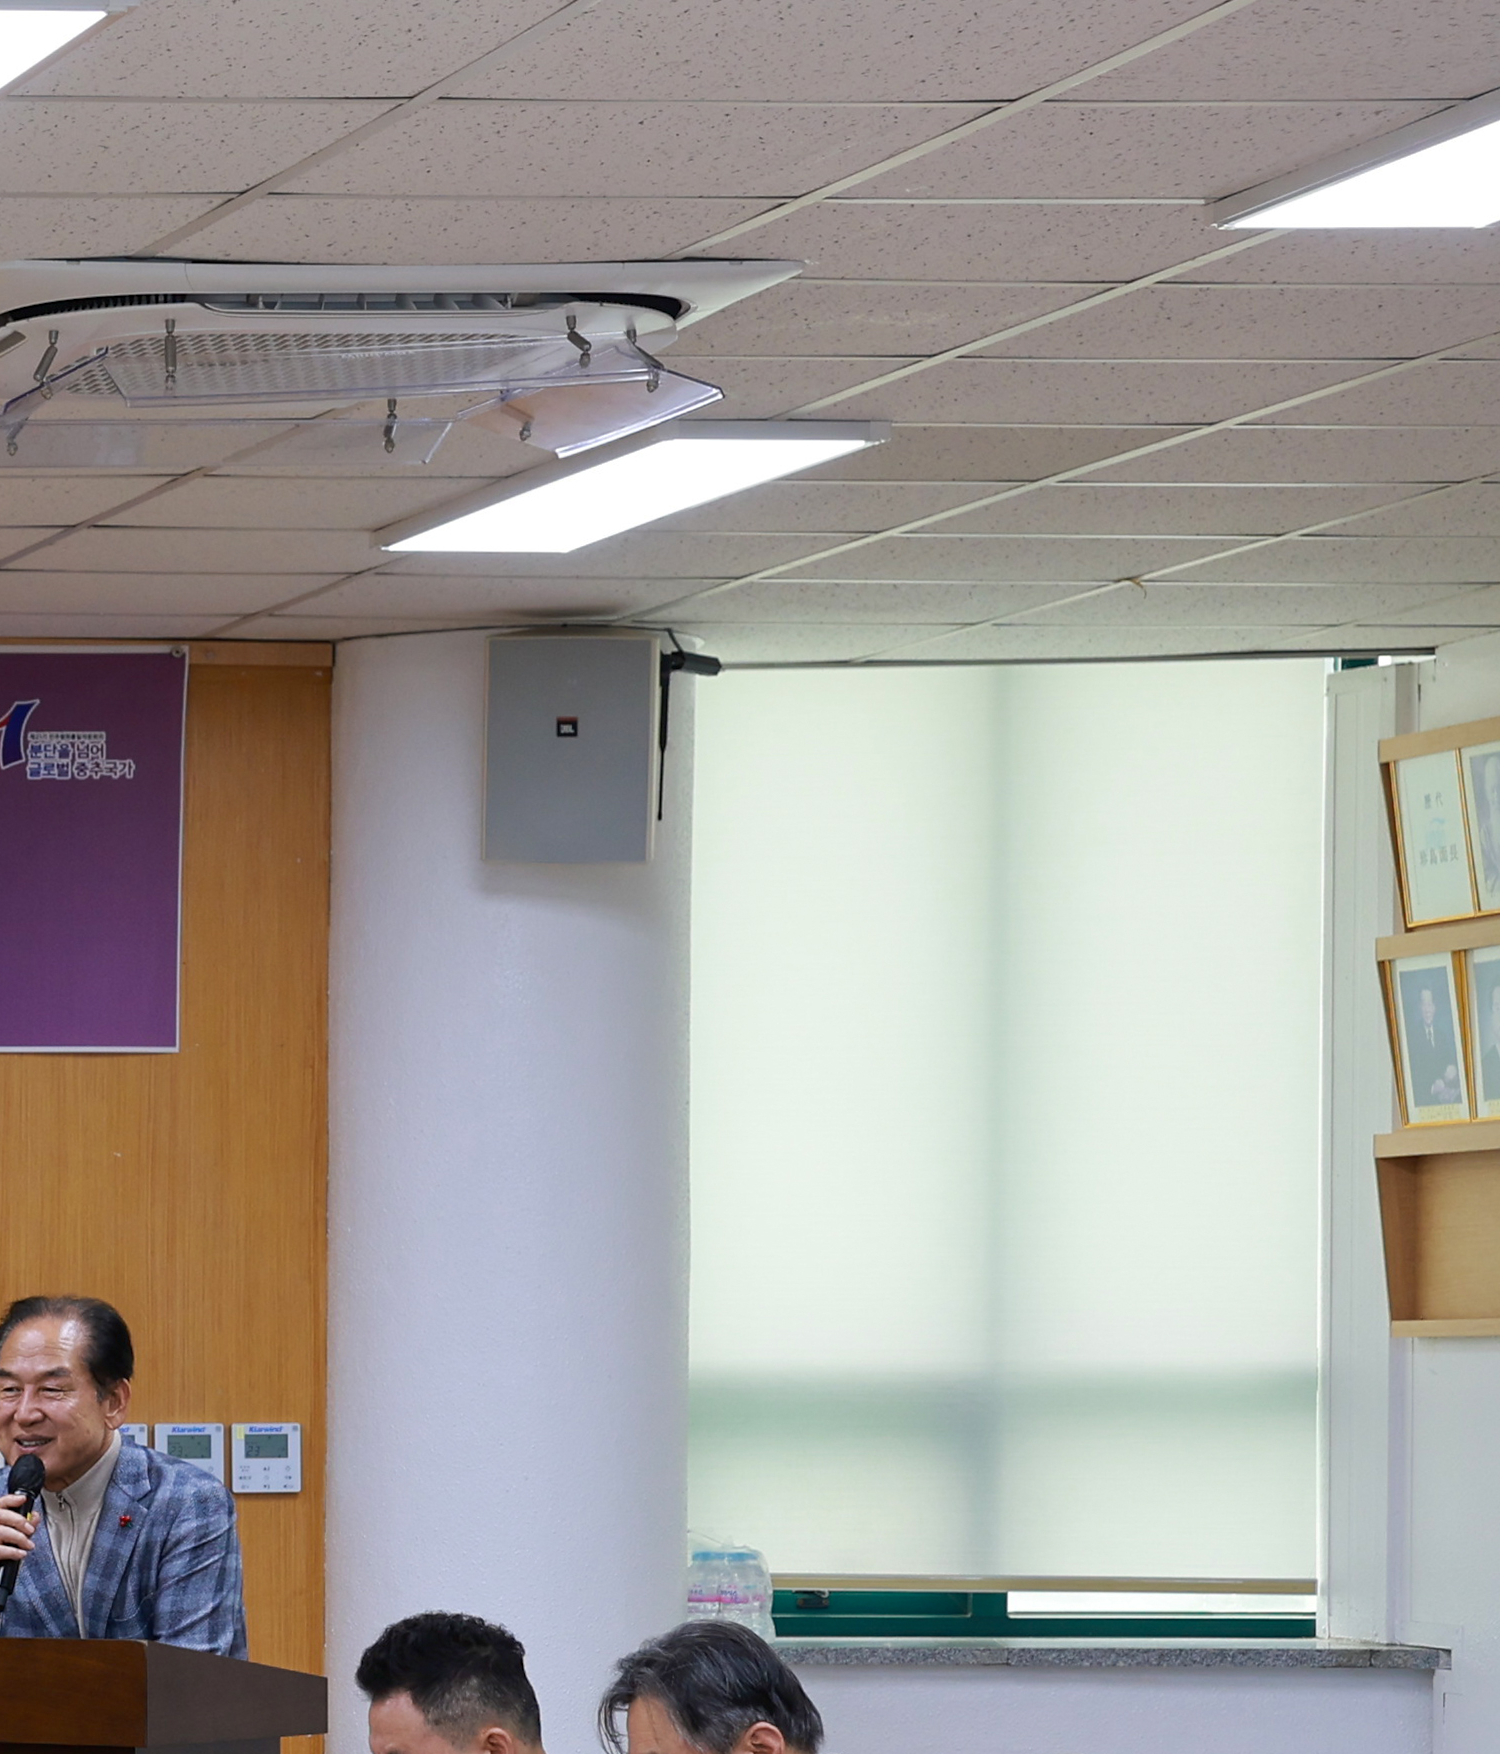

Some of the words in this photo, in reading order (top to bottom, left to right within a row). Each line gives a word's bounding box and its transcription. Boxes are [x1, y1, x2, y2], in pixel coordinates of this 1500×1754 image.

[29, 743, 71, 759] 분단을
[76, 743, 105, 759] 넘어
[29, 761, 70, 778] 글로벌
[75, 760, 134, 779] 중추국가
